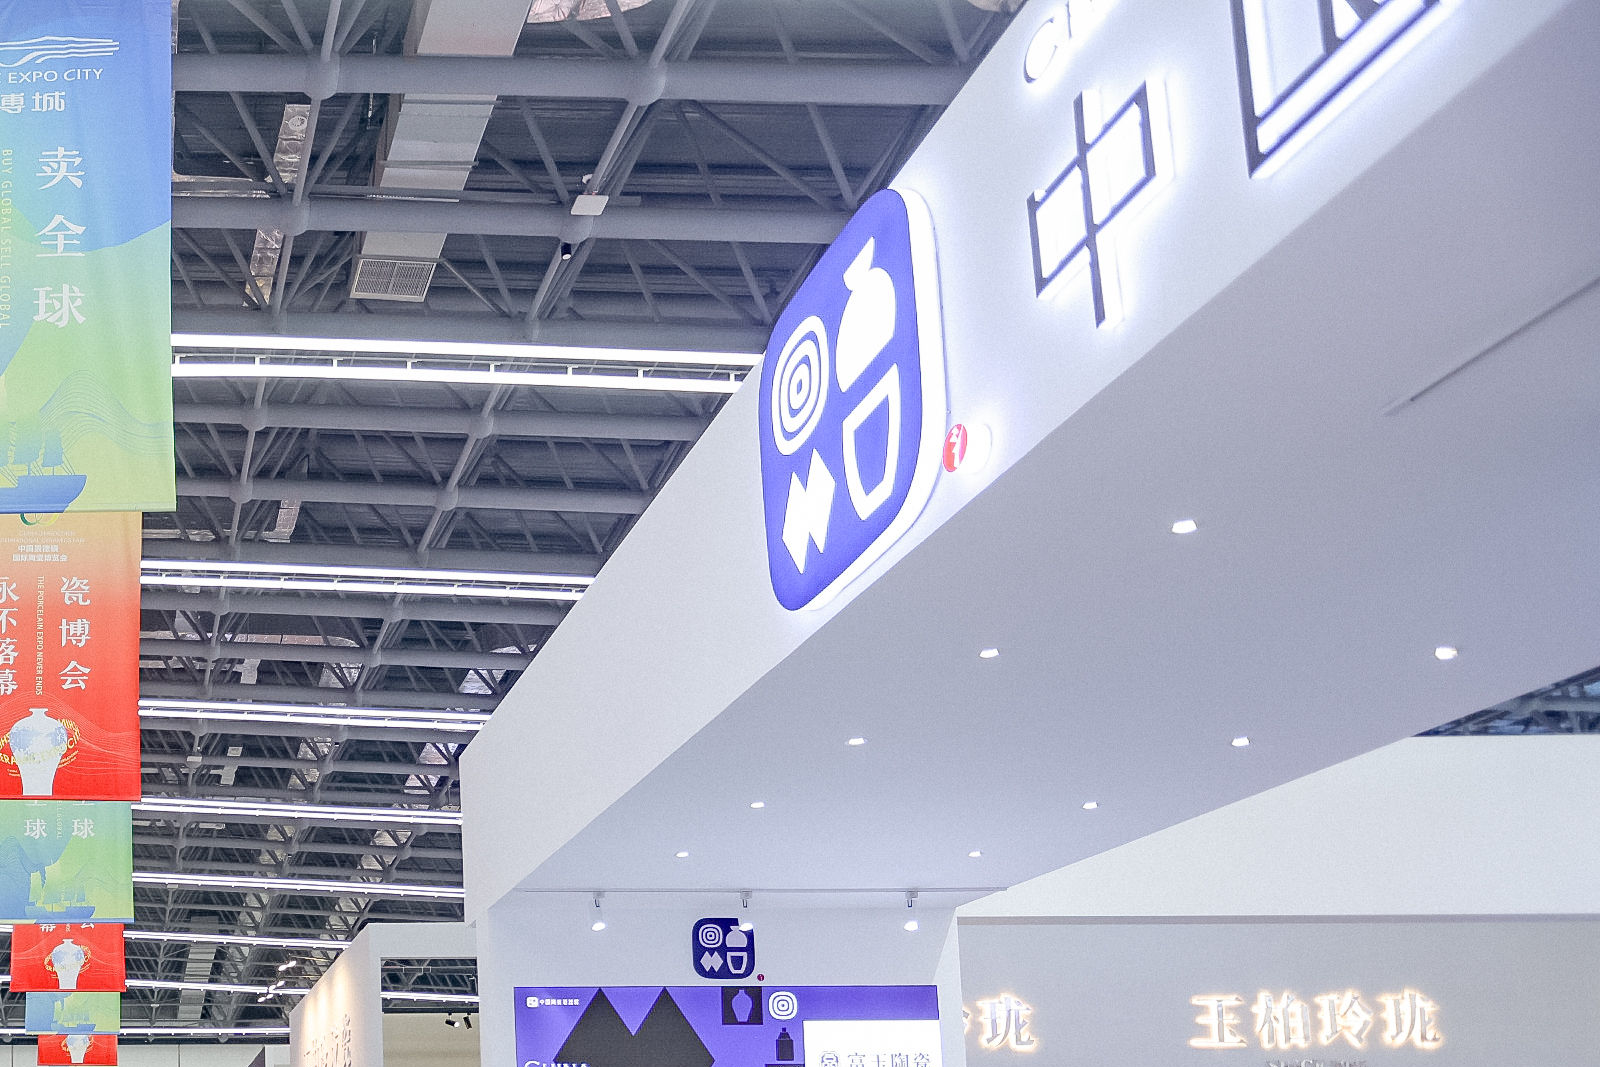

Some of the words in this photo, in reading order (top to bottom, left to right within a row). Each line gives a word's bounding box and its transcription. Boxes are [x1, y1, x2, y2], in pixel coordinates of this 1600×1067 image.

[8, 70, 58, 84] EXPO
[63, 68, 104, 81] CITY
[1, 149, 13, 174] BUY
[0, 180, 12, 232] GLOBAL
[33, 146, 88, 328] 卖全球
[0, 238, 12, 269] SELL
[0, 275, 11, 329] GLOBAL
[37, 575, 45, 588] THE
[36, 590, 45, 630] PORCELAIN
[36, 631, 44, 650] EXPO
[58, 576, 92, 690] 瓷博会
[35, 652, 44, 675] NEVER
[35, 676, 43, 696] ENDS
[1188, 989, 1443, 1048] 玉柏玲珑
